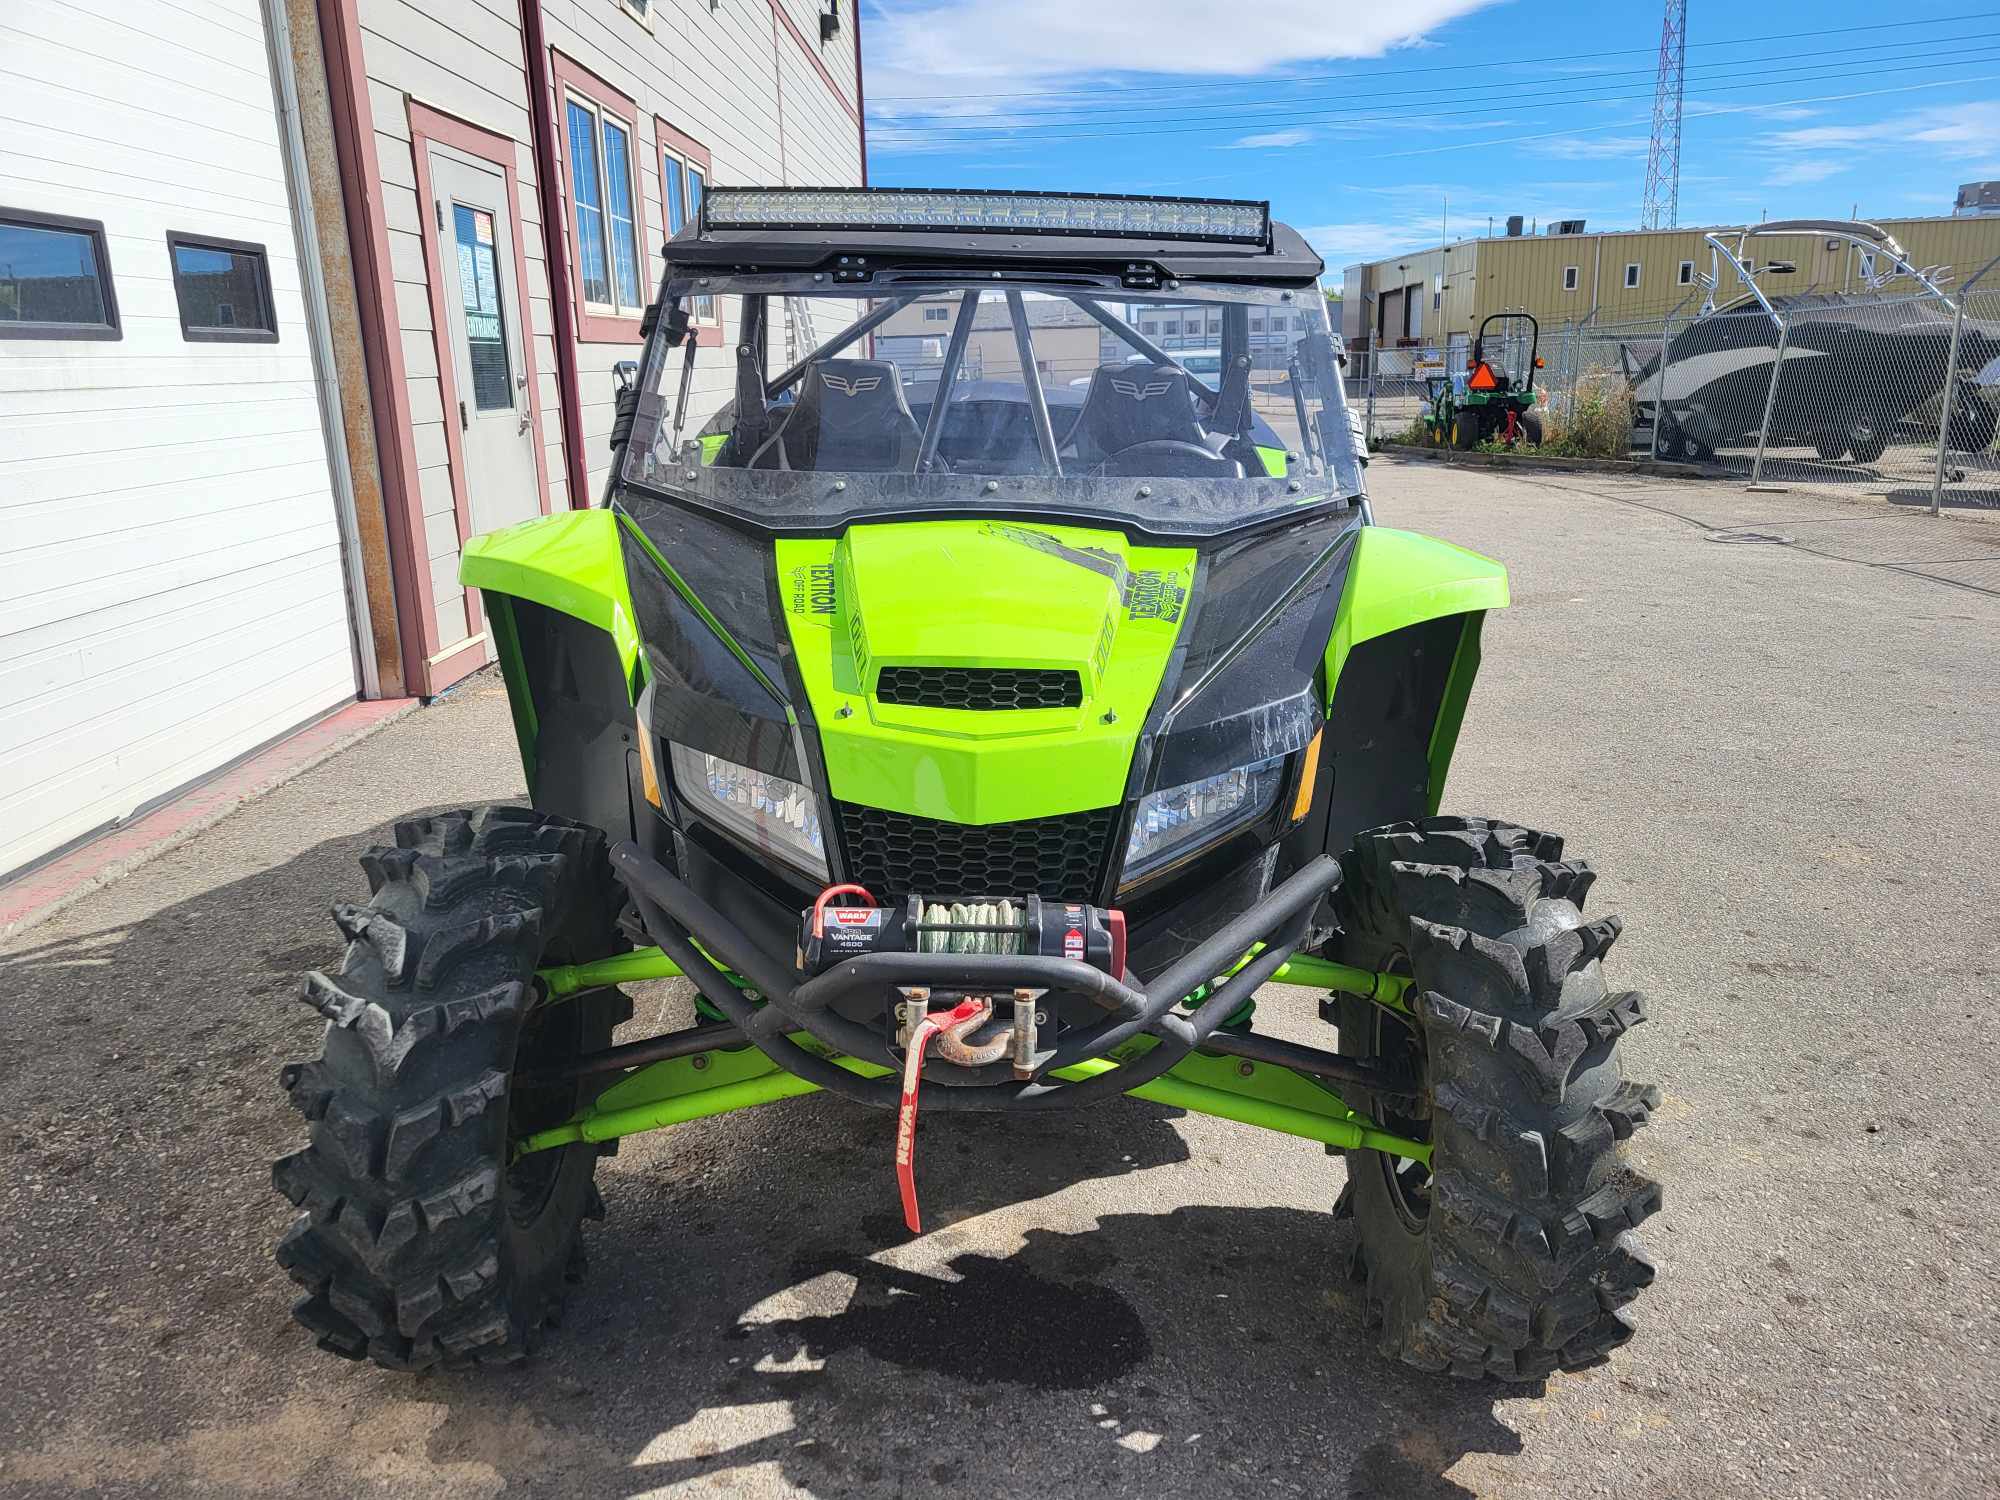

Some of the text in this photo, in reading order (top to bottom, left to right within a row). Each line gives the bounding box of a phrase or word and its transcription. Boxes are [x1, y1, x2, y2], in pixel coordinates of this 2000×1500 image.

[466, 317, 500, 338] ENTRANCE
[793, 579, 805, 614] OFF ROAD
[811, 564, 837, 615] TEXTRON
[1129, 570, 1162, 620] TEXTRON
[838, 912, 867, 920] WARN
[831, 933, 873, 941] VANTAGE
[896, 1104, 913, 1165] WARN
